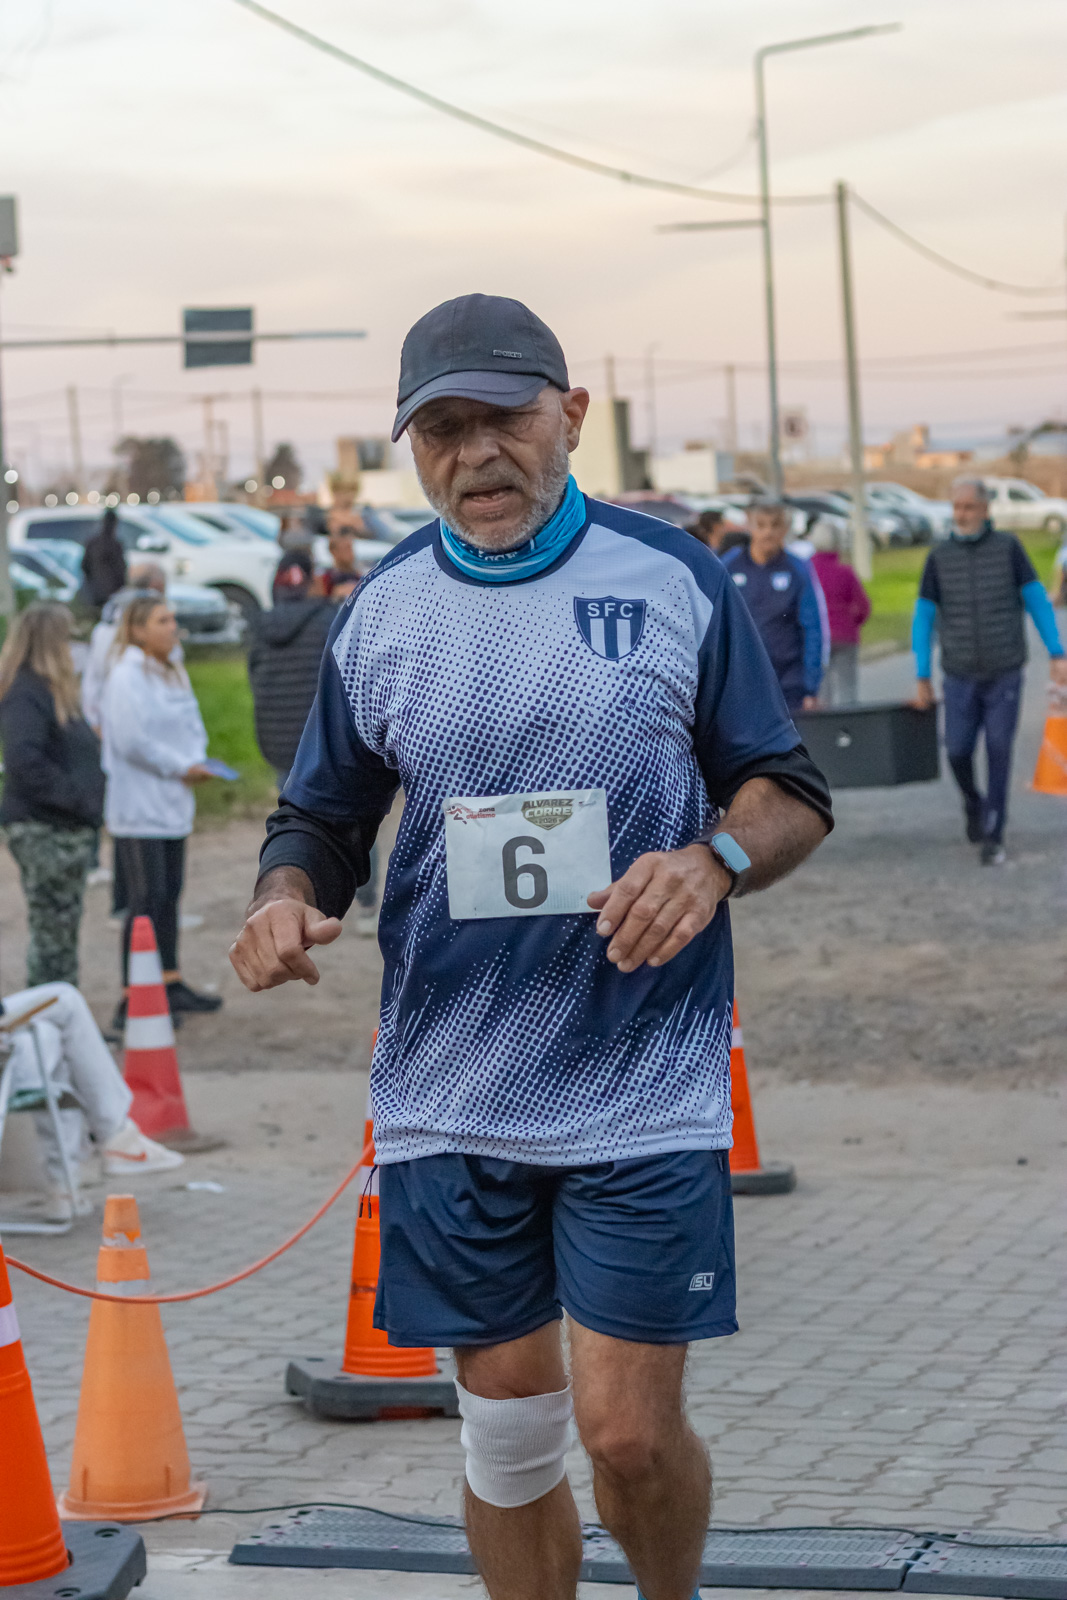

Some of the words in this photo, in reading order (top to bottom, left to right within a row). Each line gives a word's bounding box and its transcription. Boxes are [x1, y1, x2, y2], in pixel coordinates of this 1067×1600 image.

[587, 602, 633, 618] SFC
[522, 798, 575, 809] ALVAREZ
[524, 806, 573, 818] CORRE
[502, 835, 548, 909] 6
